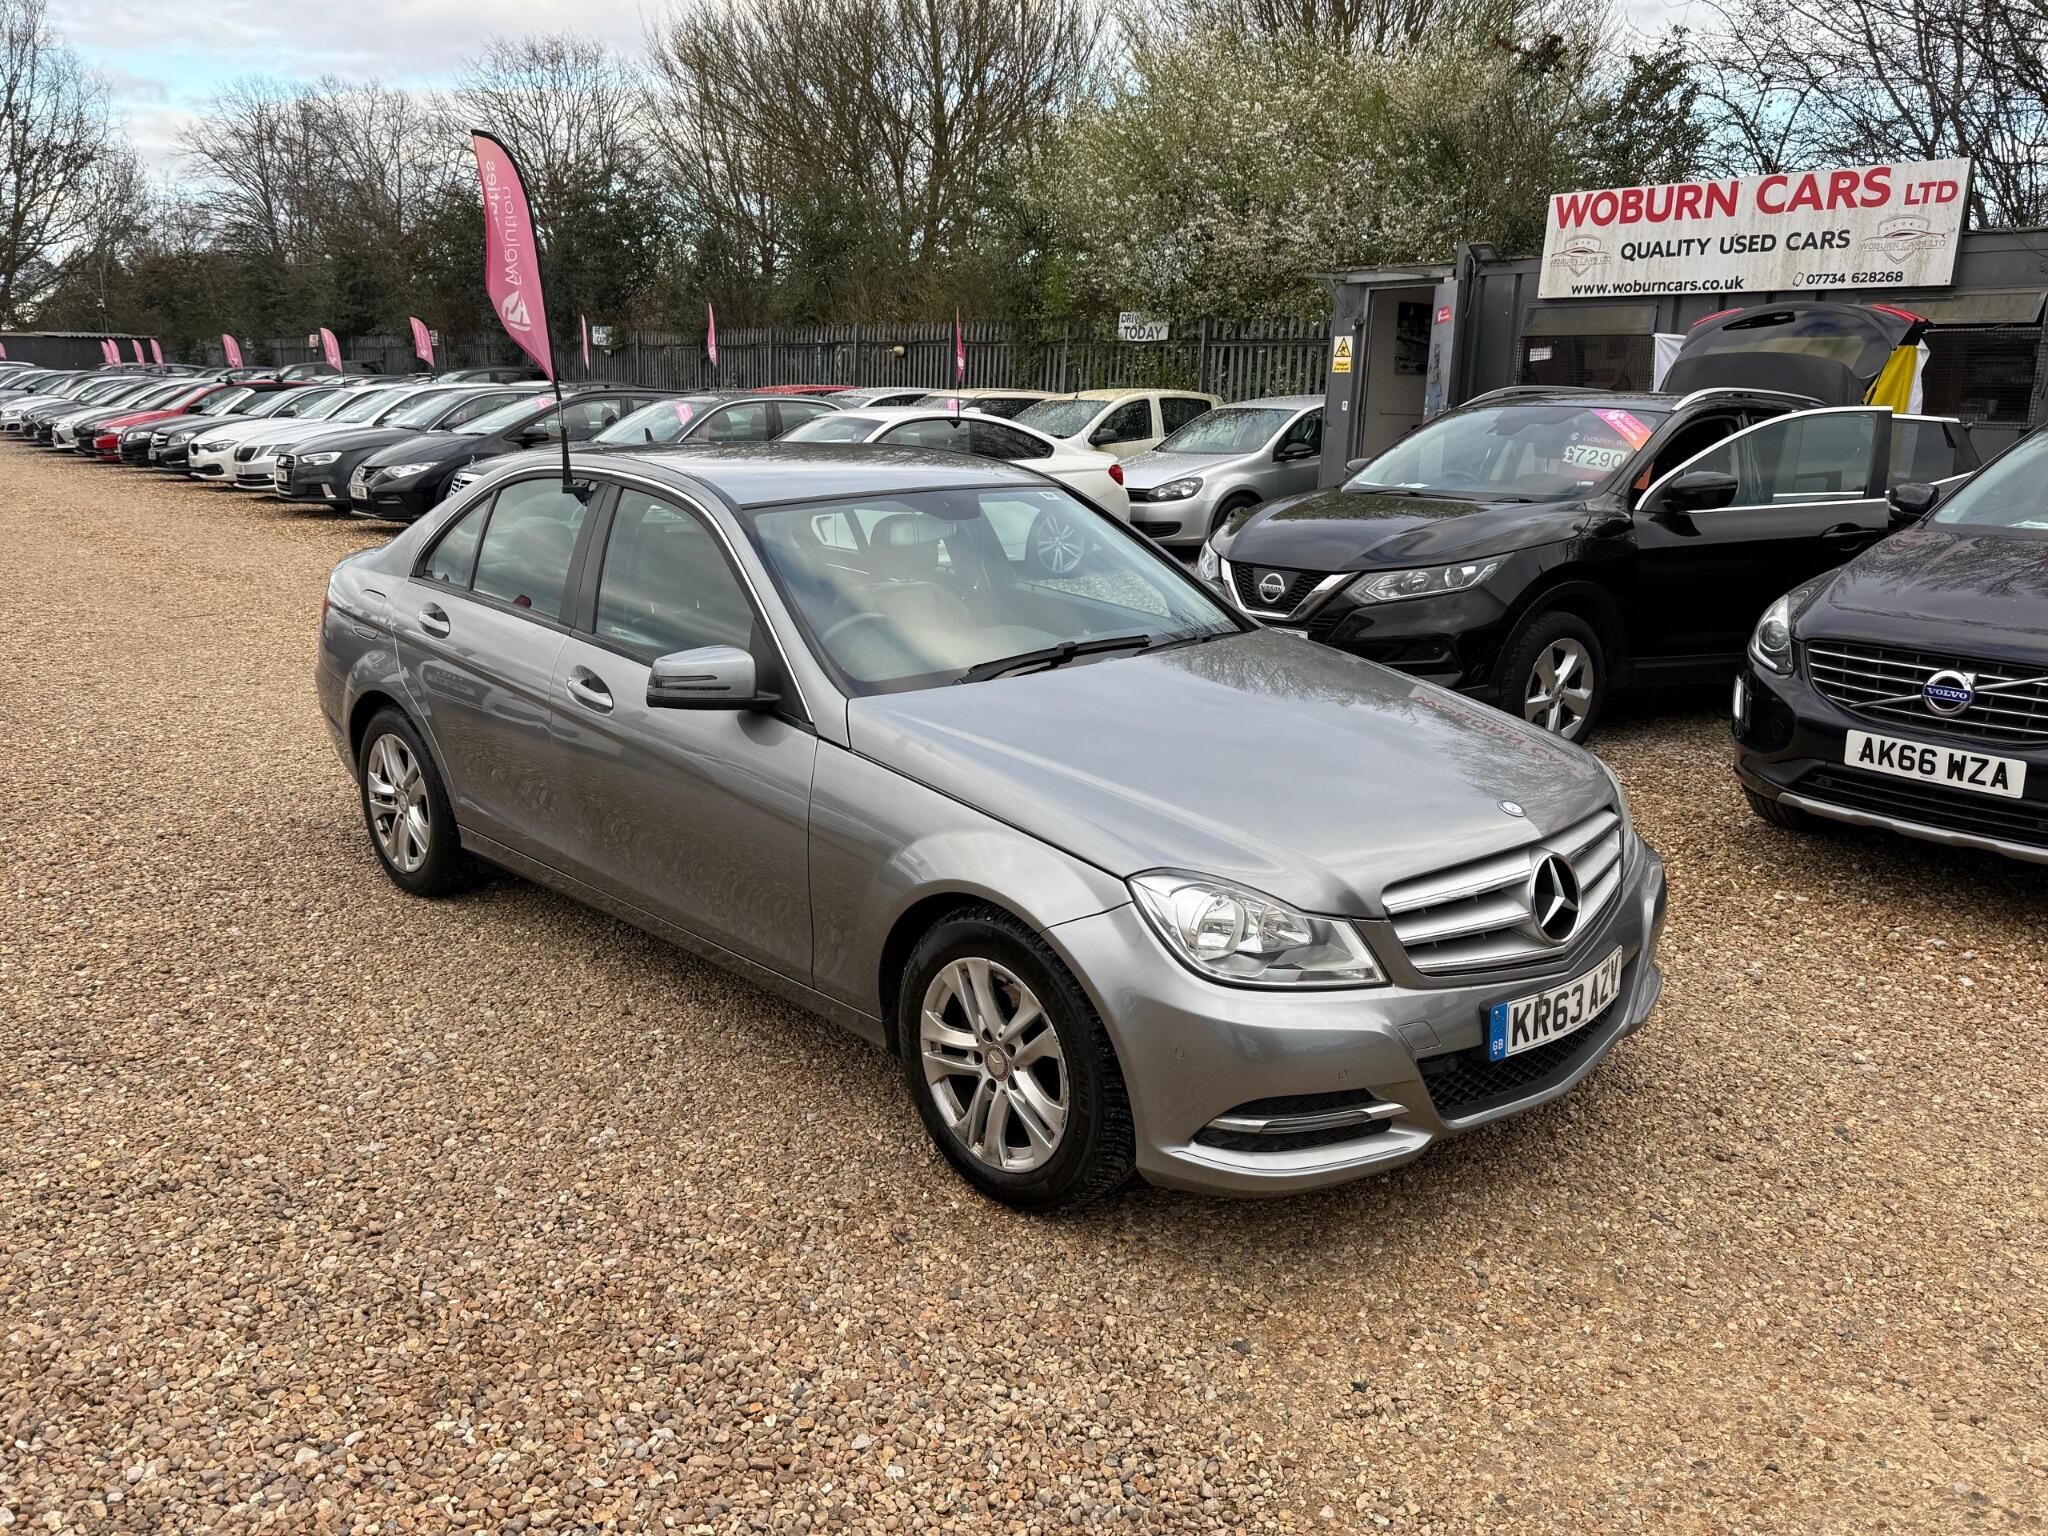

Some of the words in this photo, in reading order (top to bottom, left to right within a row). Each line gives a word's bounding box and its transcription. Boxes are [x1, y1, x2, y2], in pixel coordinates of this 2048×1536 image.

[1556, 181, 1739, 229] WOBURN
[1756, 167, 1892, 215] CARS
[1904, 180, 1959, 205] LTD
[1621, 237, 1712, 261] QUALITY
[1720, 233, 1776, 254] USED
[1785, 229, 1850, 250] CARS
[1860, 241, 1900, 251] WOBURN
[1902, 240, 1927, 249] CARS
[1928, 239, 1946, 247] LTD
[1571, 275, 1745, 294] www.woburncars.co.uk
[1806, 272, 1846, 285] 07734
[1851, 271, 1904, 283] 628268
[1123, 325, 1162, 339] TODAY
[1562, 446, 1624, 469] £7290
[1927, 687, 1968, 700] VOLVO
[1859, 737, 1938, 775] AK66
[1946, 752, 2009, 790] WZA
[1511, 983, 1584, 1047] KR63
[1589, 956, 1619, 1014] AZV
[1492, 1038, 1504, 1051] GB
